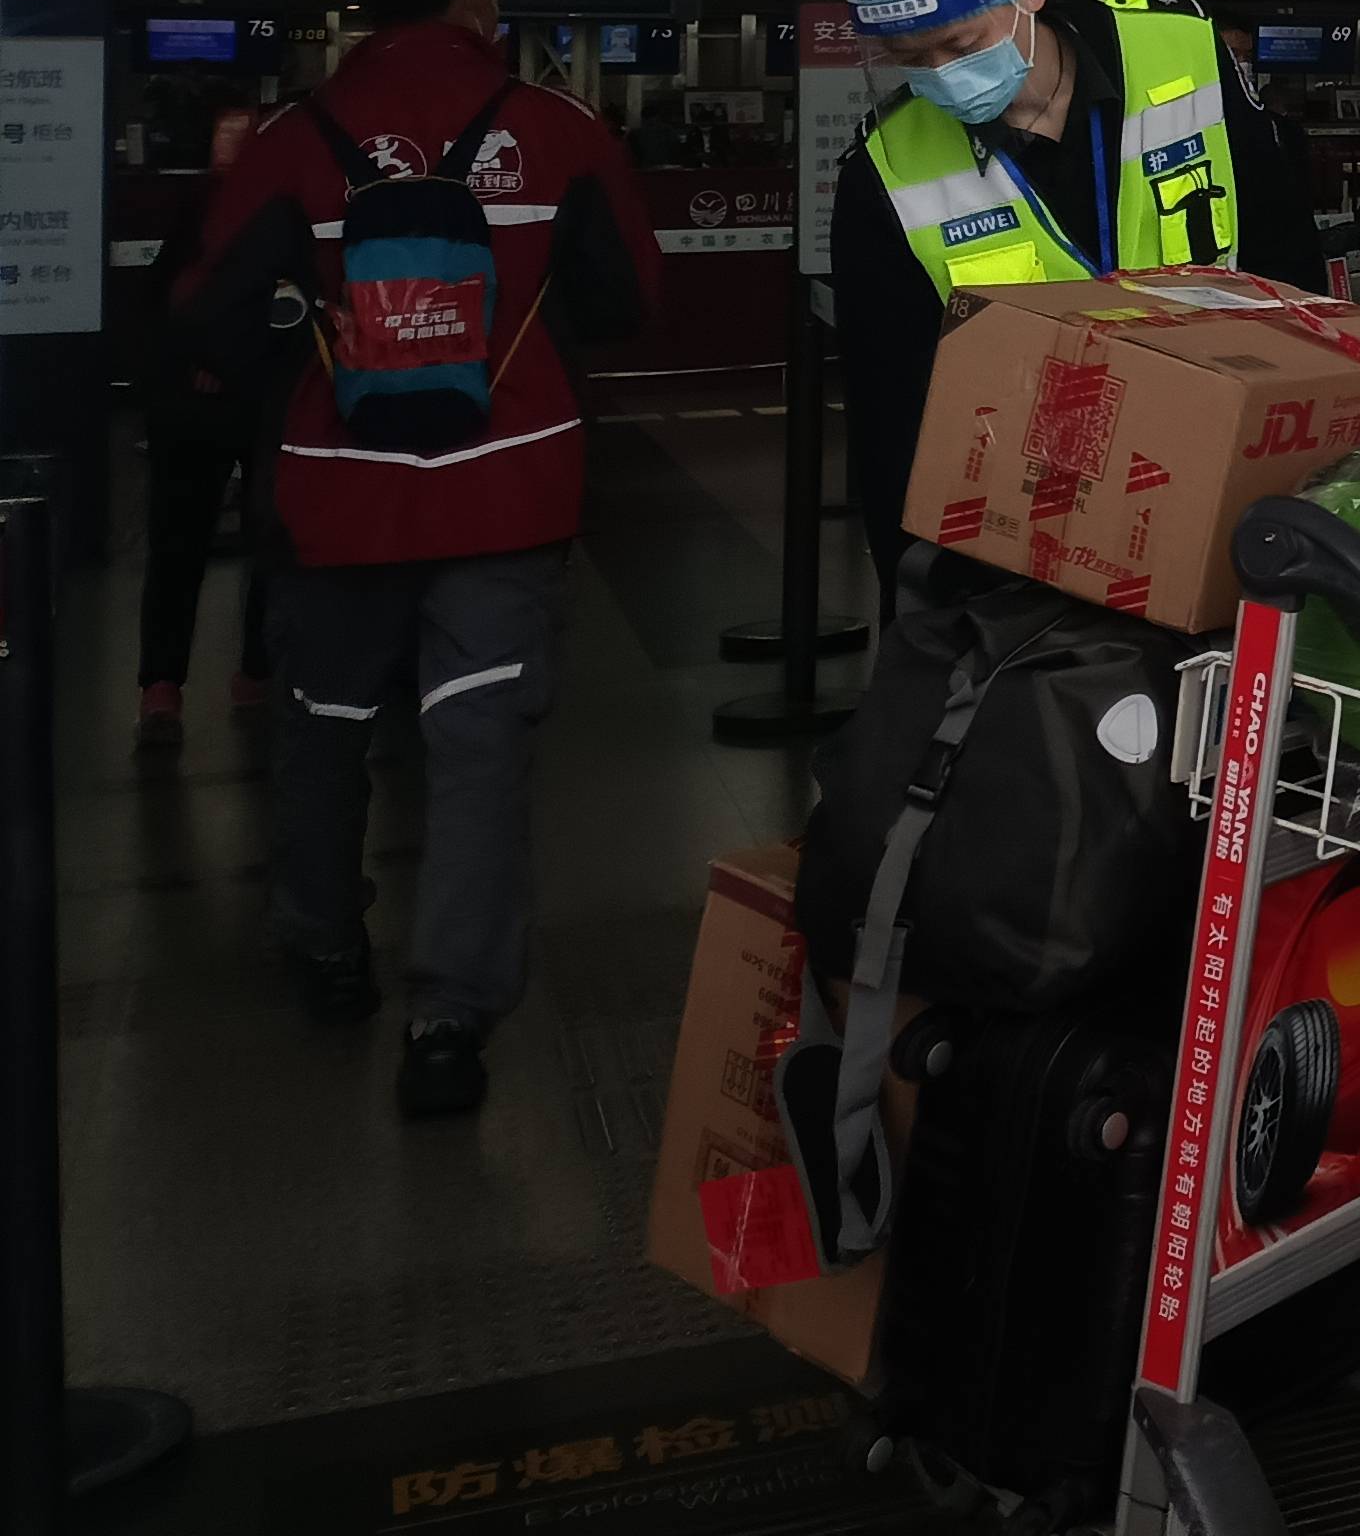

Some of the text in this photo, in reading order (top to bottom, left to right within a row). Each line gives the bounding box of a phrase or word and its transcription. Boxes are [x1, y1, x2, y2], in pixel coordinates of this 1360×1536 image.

[248, 20, 275, 37] 75
[1331, 26, 1351, 42] 69
[1147, 136, 1200, 173] 护卫
[948, 212, 1015, 244] HUWEI
[1242, 399, 1319, 459] JDL
[1230, 672, 1267, 865] CHAO YANG
[1157, 892, 1235, 1323] 有太阳升起的地方就有朝阳轮胎
